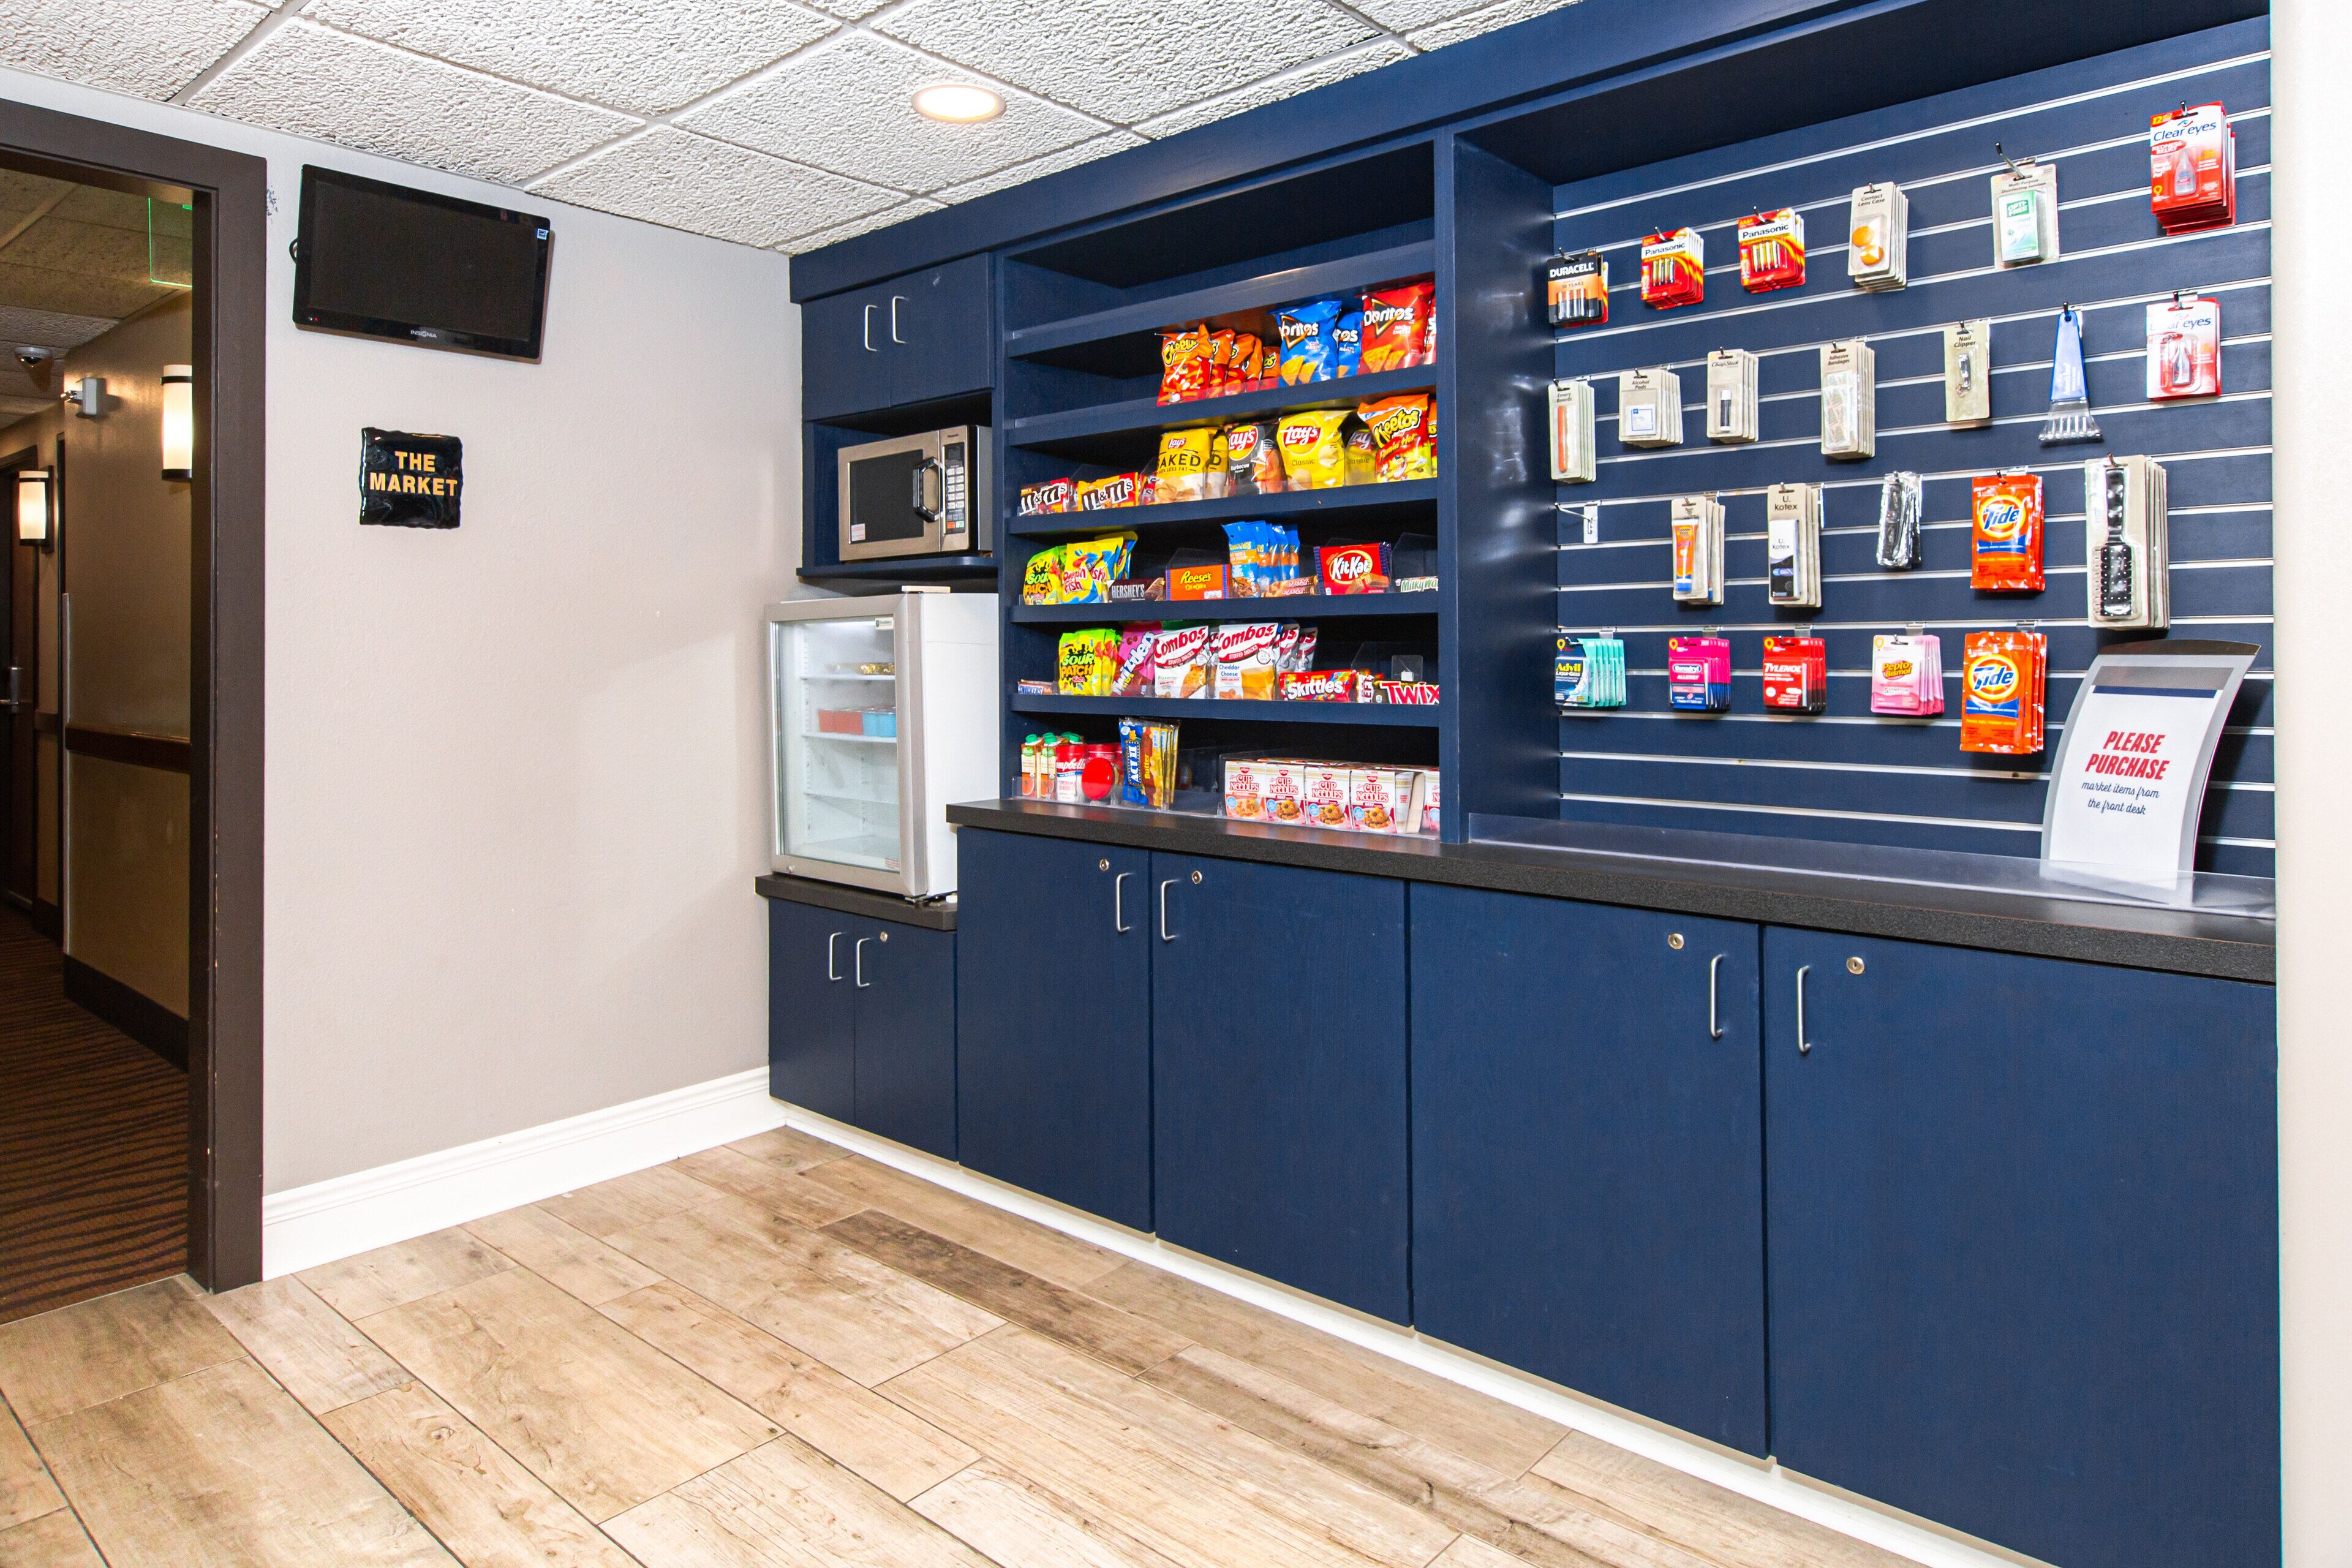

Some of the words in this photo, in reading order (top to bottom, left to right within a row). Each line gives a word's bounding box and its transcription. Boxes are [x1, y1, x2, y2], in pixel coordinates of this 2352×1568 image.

[2154, 128, 2185, 141] Clear
[2187, 122, 2217, 135] eyes
[1743, 224, 1789, 239] Panasonic
[1645, 243, 1686, 256] Panasonic
[1550, 262, 1594, 277] DURACELL
[1363, 306, 1415, 327] Doritos
[2183, 317, 2212, 330] eyes
[410, 330, 437, 338] INSIGNIA
[1278, 322, 1319, 339] oritos
[1373, 407, 1422, 449] Cheetos
[1169, 438, 1186, 448] Lay's
[1285, 426, 1319, 446] Lay's
[394, 450, 436, 472] THE
[1157, 454, 1201, 469] AKED
[1291, 458, 1316, 467] Classic
[369, 472, 458, 497] MARKET
[1983, 505, 2020, 530] Tide
[1180, 570, 1212, 584] Reese's
[1064, 577, 1086, 595] Fish
[1111, 584, 1145, 599] HERSHEY'S
[1401, 579, 1425, 592] Milky
[1154, 627, 1207, 658] Combos
[1243, 645, 1258, 656] SNACKS
[1061, 653, 1095, 666] SOUR
[1060, 664, 1094, 680] PATCH
[1556, 663, 1581, 672] Advil
[1764, 663, 1802, 673] TYLENOL
[1885, 666, 1912, 679] Bismol
[1973, 666, 2015, 691] Tide
[1018, 685, 1043, 695] SNICKERS
[1286, 677, 1345, 700] Skittles
[2103, 731, 2166, 754] PLEASE
[1128, 745, 1137, 759] II
[1130, 760, 1139, 783] ACT
[2085, 753, 2171, 780] PURCHASE
[1236, 774, 1254, 784] CUP
[1276, 777, 1293, 786] CUP
[1319, 780, 1337, 791] CUP
[1229, 781, 1260, 792] NOODLES
[1269, 784, 1299, 795] NOODLES
[1363, 783, 1382, 793] CUP
[2081, 782, 2112, 793] market
[2113, 783, 2135, 796] items
[2136, 786, 2160, 801] from
[1311, 788, 1344, 800] NOODLES
[1356, 791, 1389, 803] NOODLES
[2087, 798, 2100, 809] the
[2101, 800, 2124, 814] front
[2126, 804, 2146, 815] desk
